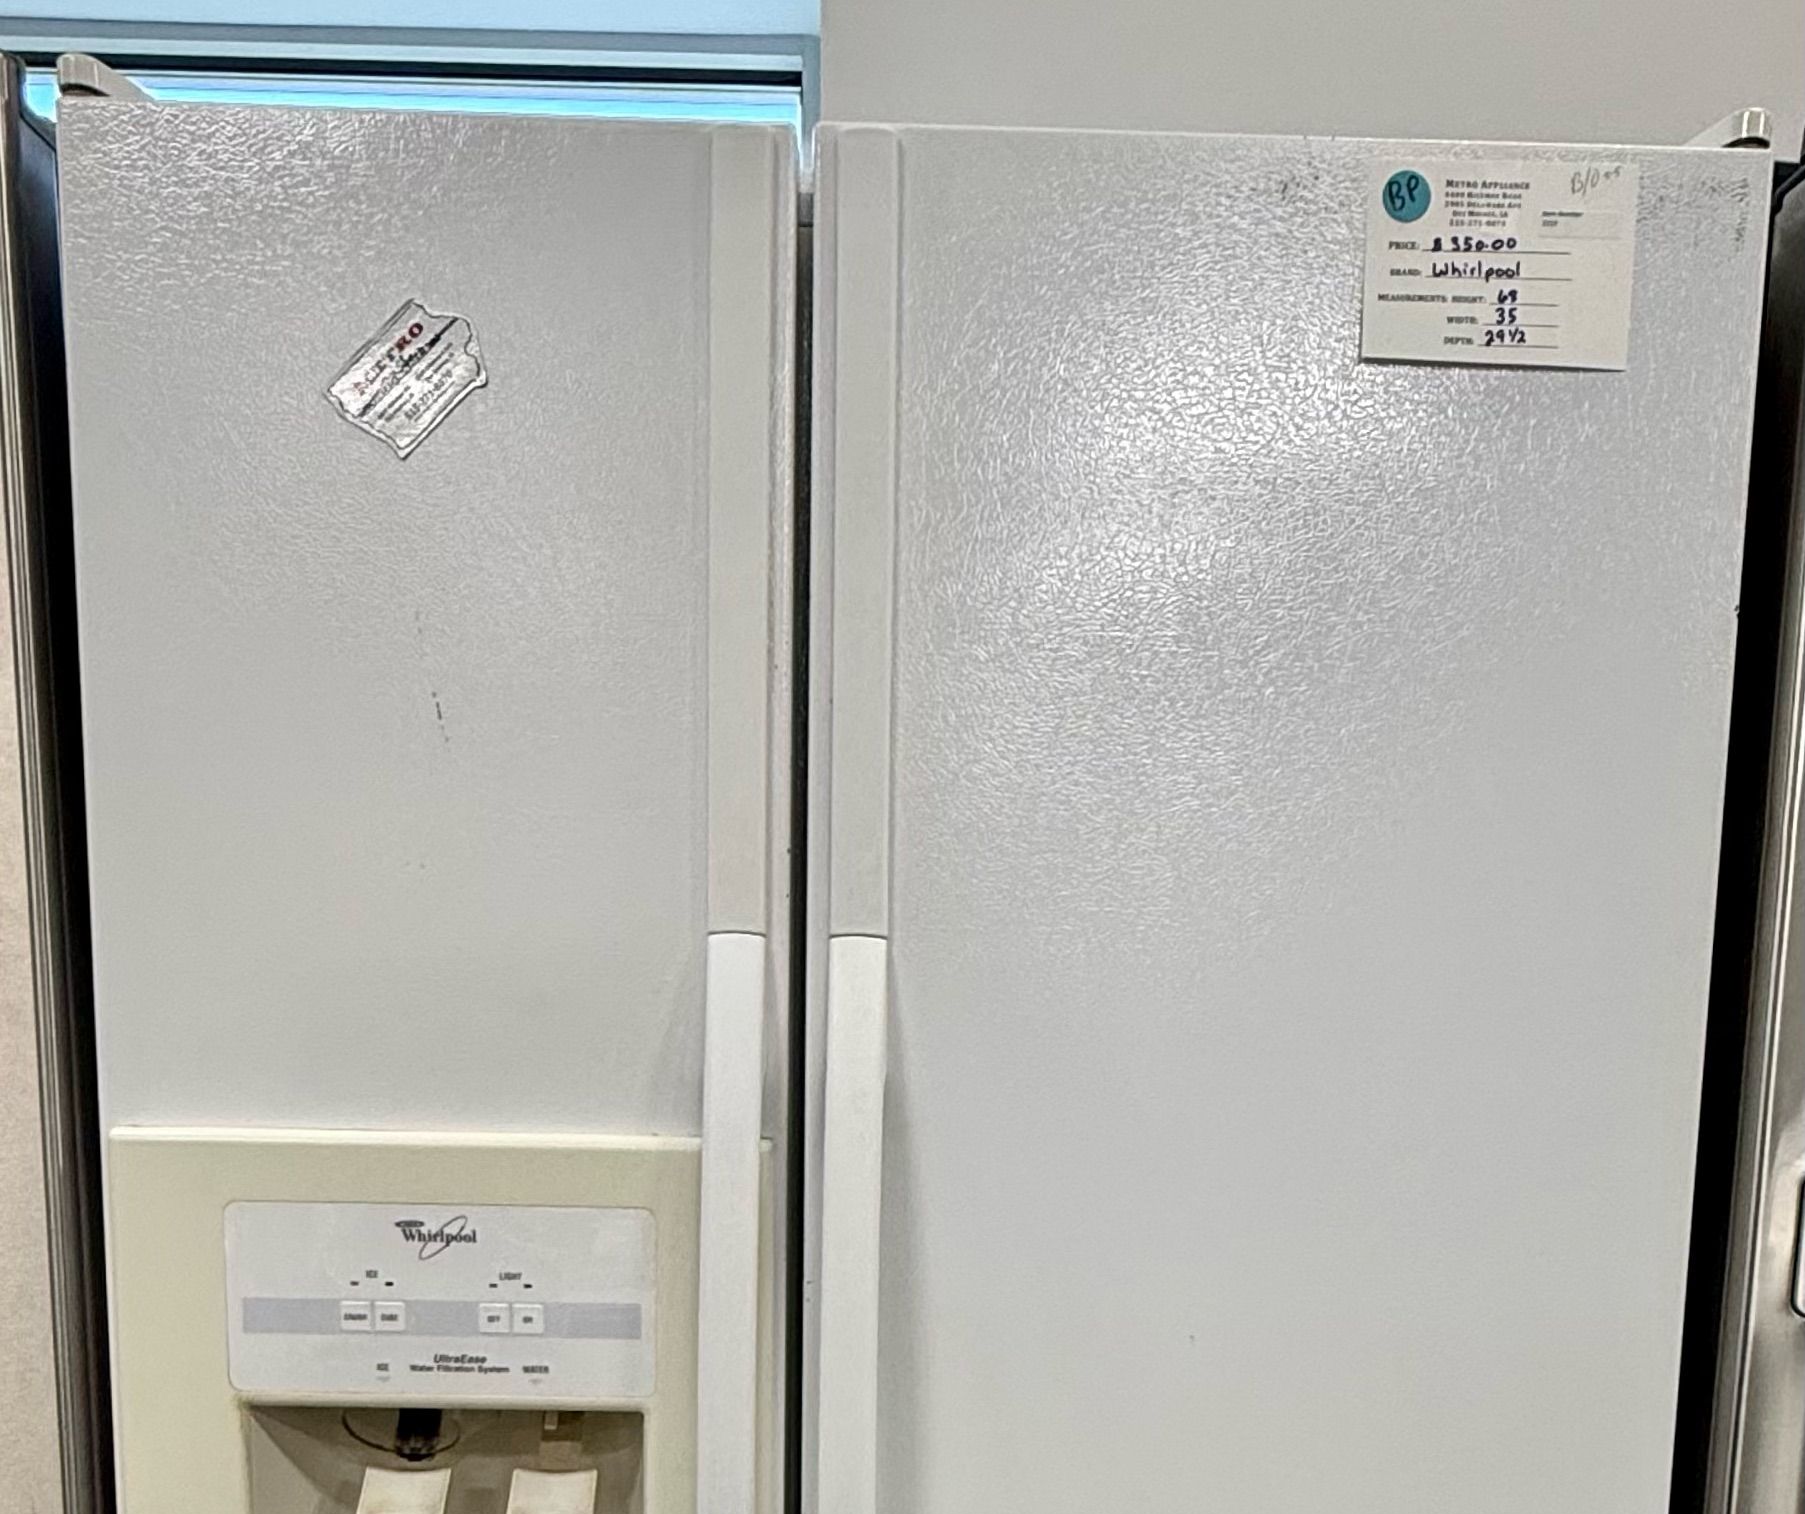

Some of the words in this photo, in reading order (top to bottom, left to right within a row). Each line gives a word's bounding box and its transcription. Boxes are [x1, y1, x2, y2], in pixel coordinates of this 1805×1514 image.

[1388, 174, 1420, 211] BP
[1432, 260, 1521, 282] Whirlpool
[1495, 307, 1517, 325] 35
